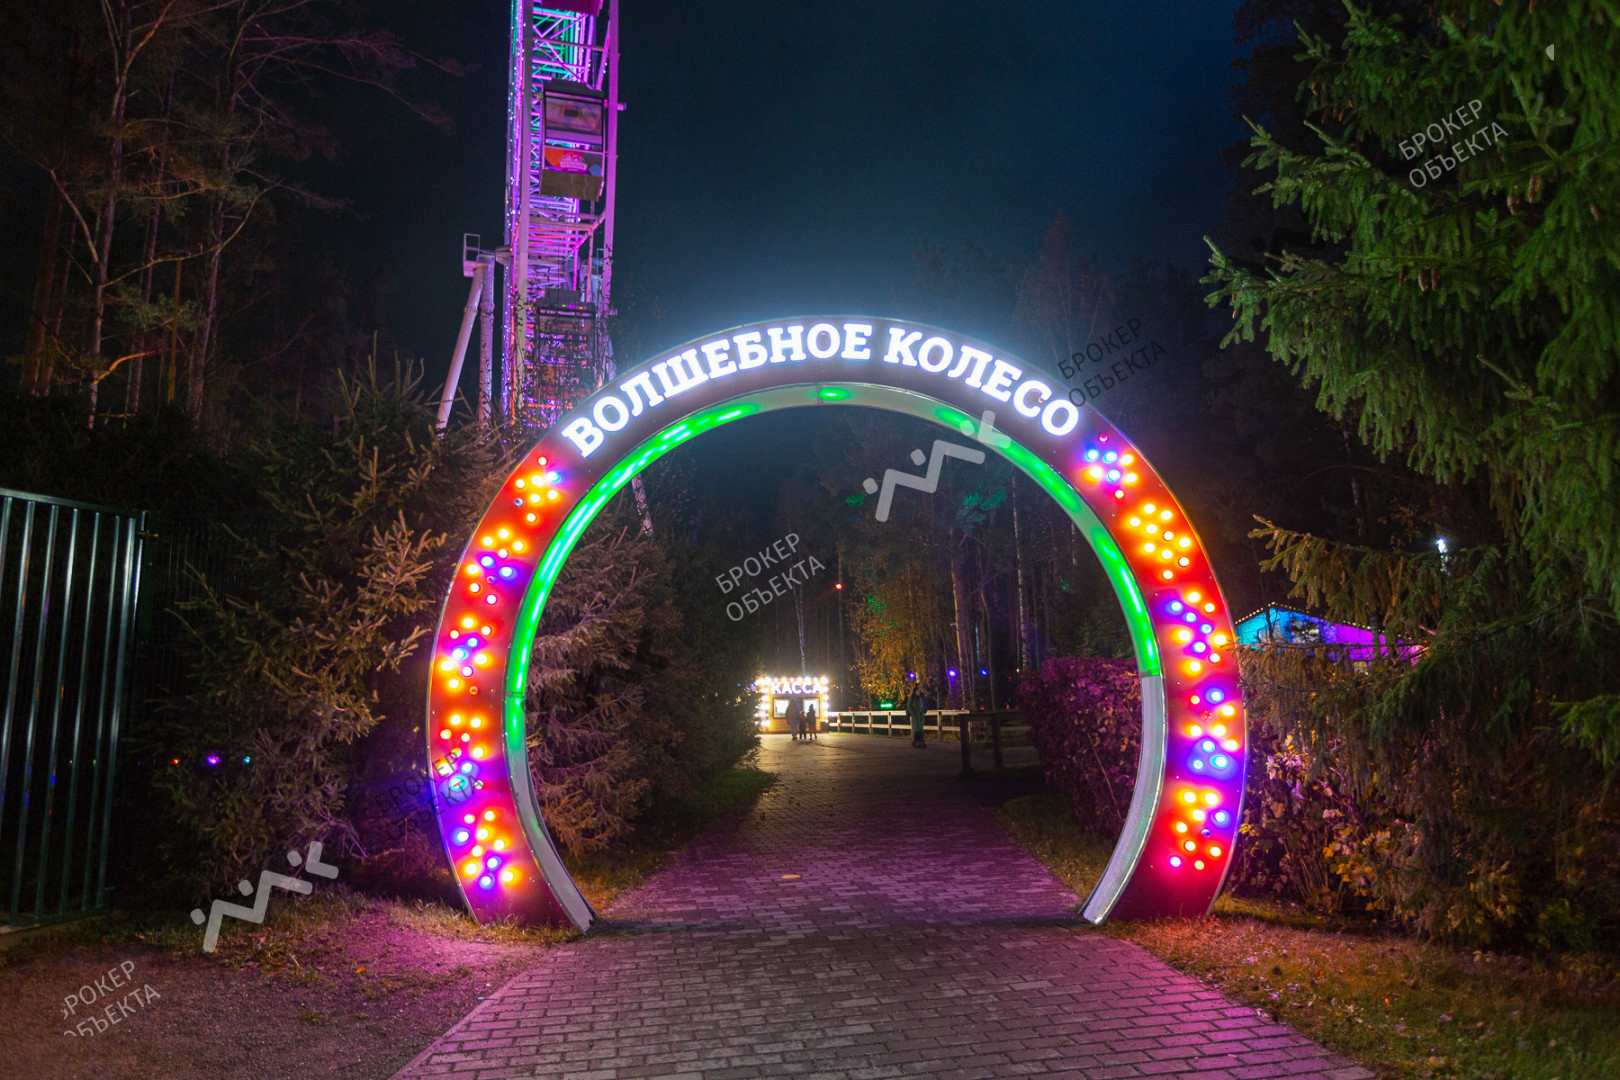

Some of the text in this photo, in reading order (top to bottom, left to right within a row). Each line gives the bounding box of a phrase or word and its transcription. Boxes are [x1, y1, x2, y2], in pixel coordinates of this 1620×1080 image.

[561, 322, 1079, 458] ВОЛШЕБНОЕ КОЛЕСО
[770, 680, 823, 695] КАССА
